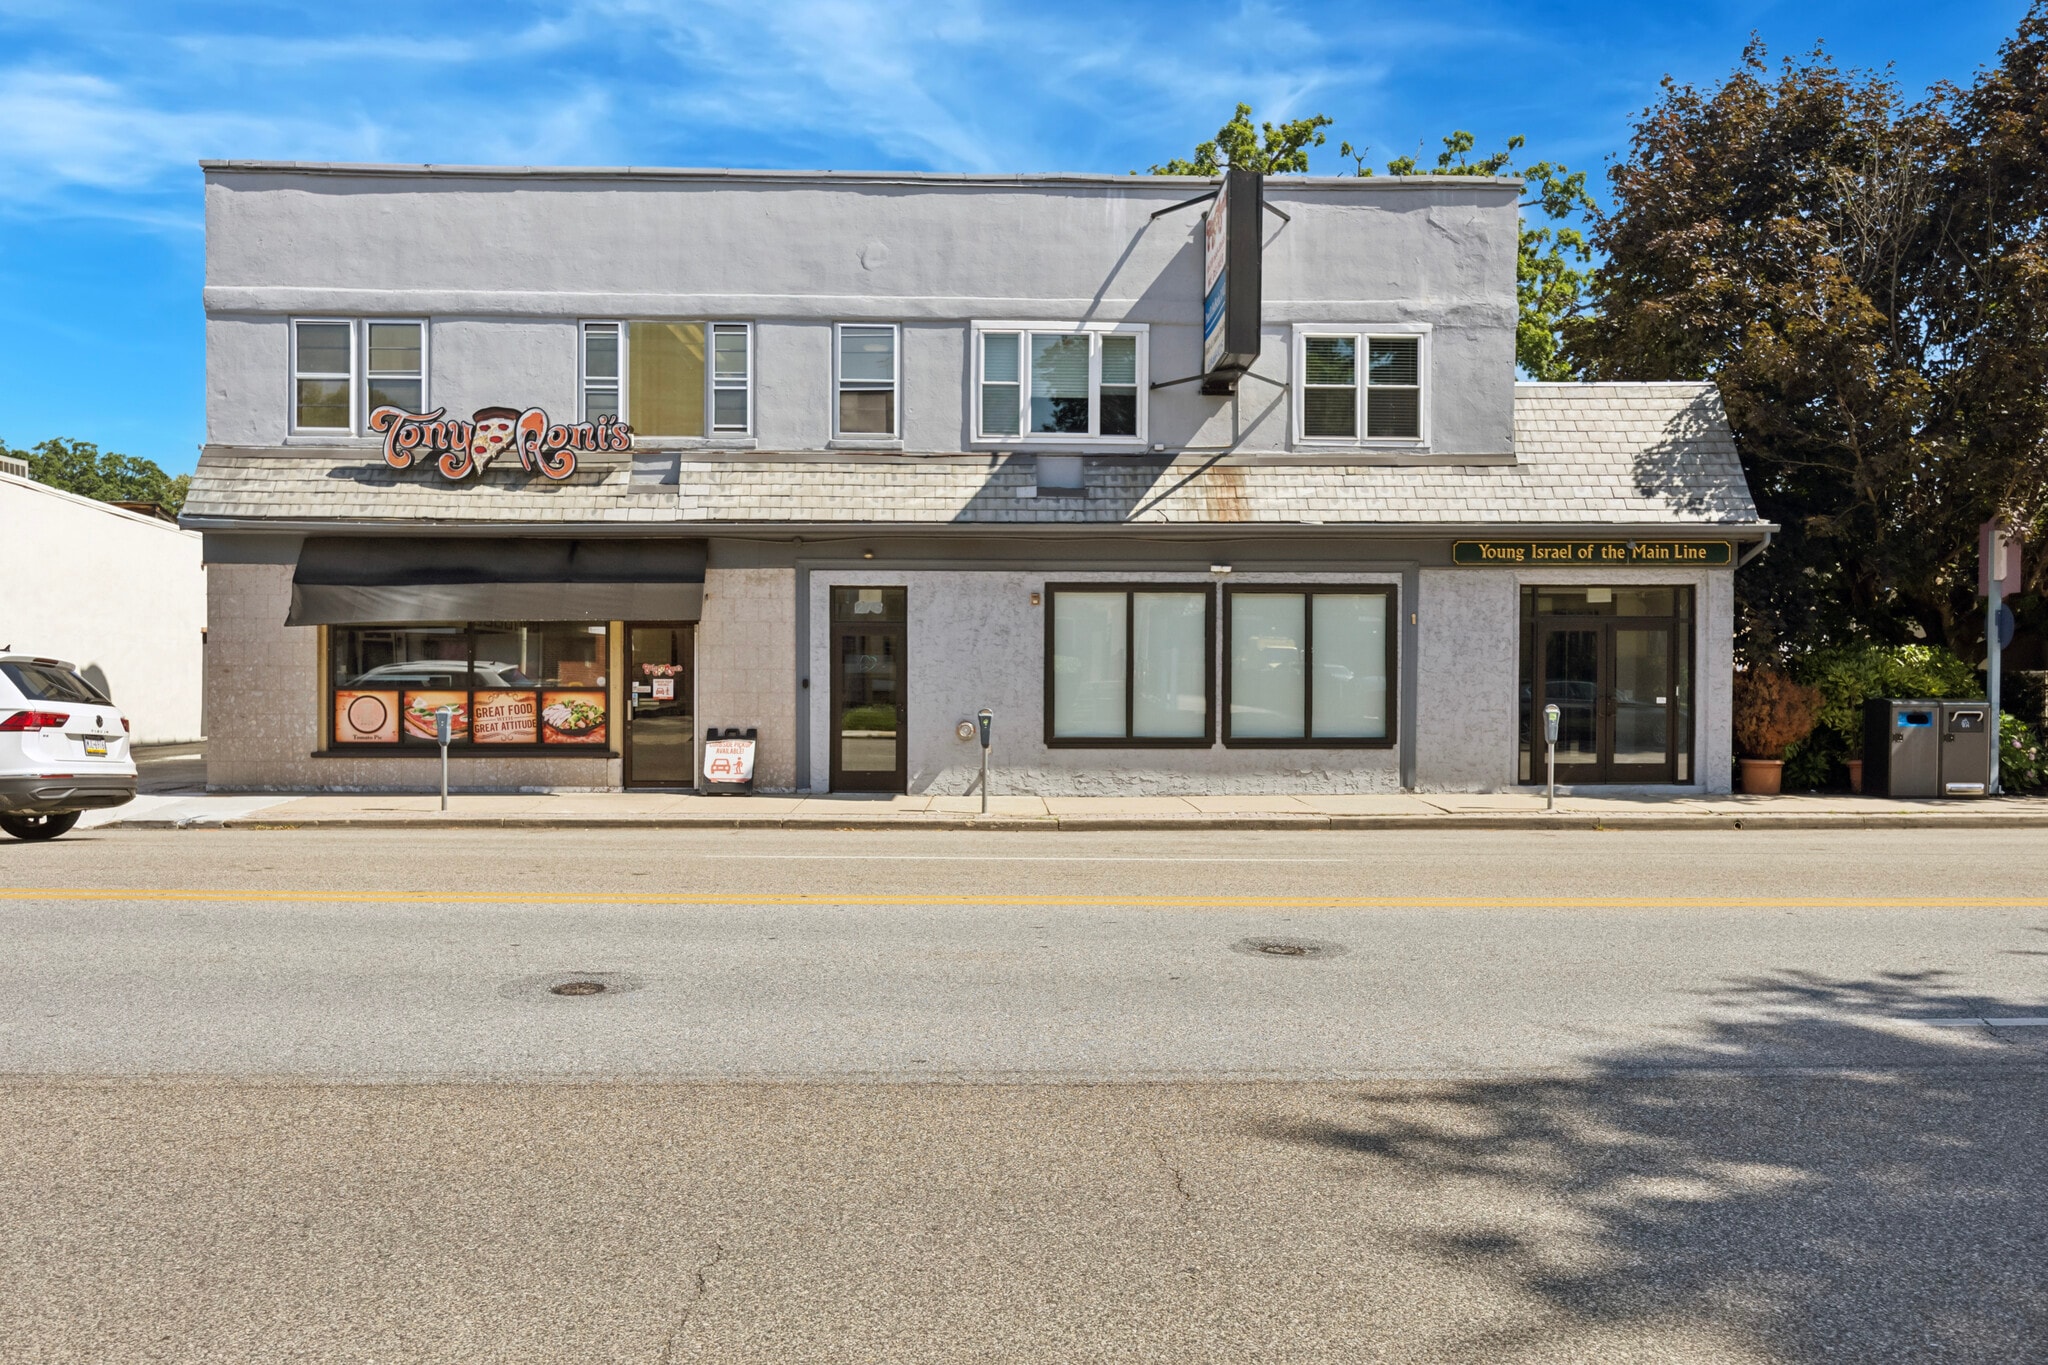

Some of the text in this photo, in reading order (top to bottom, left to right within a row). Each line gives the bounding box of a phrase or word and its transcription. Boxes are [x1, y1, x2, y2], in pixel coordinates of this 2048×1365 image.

[368, 405, 633, 480] Tony Roni's
[1478, 543, 1707, 562] Young Israel of the Main Line
[475, 703, 533, 719] GREAT FOOD
[474, 718, 537, 734] GREAT ATTITUDE
